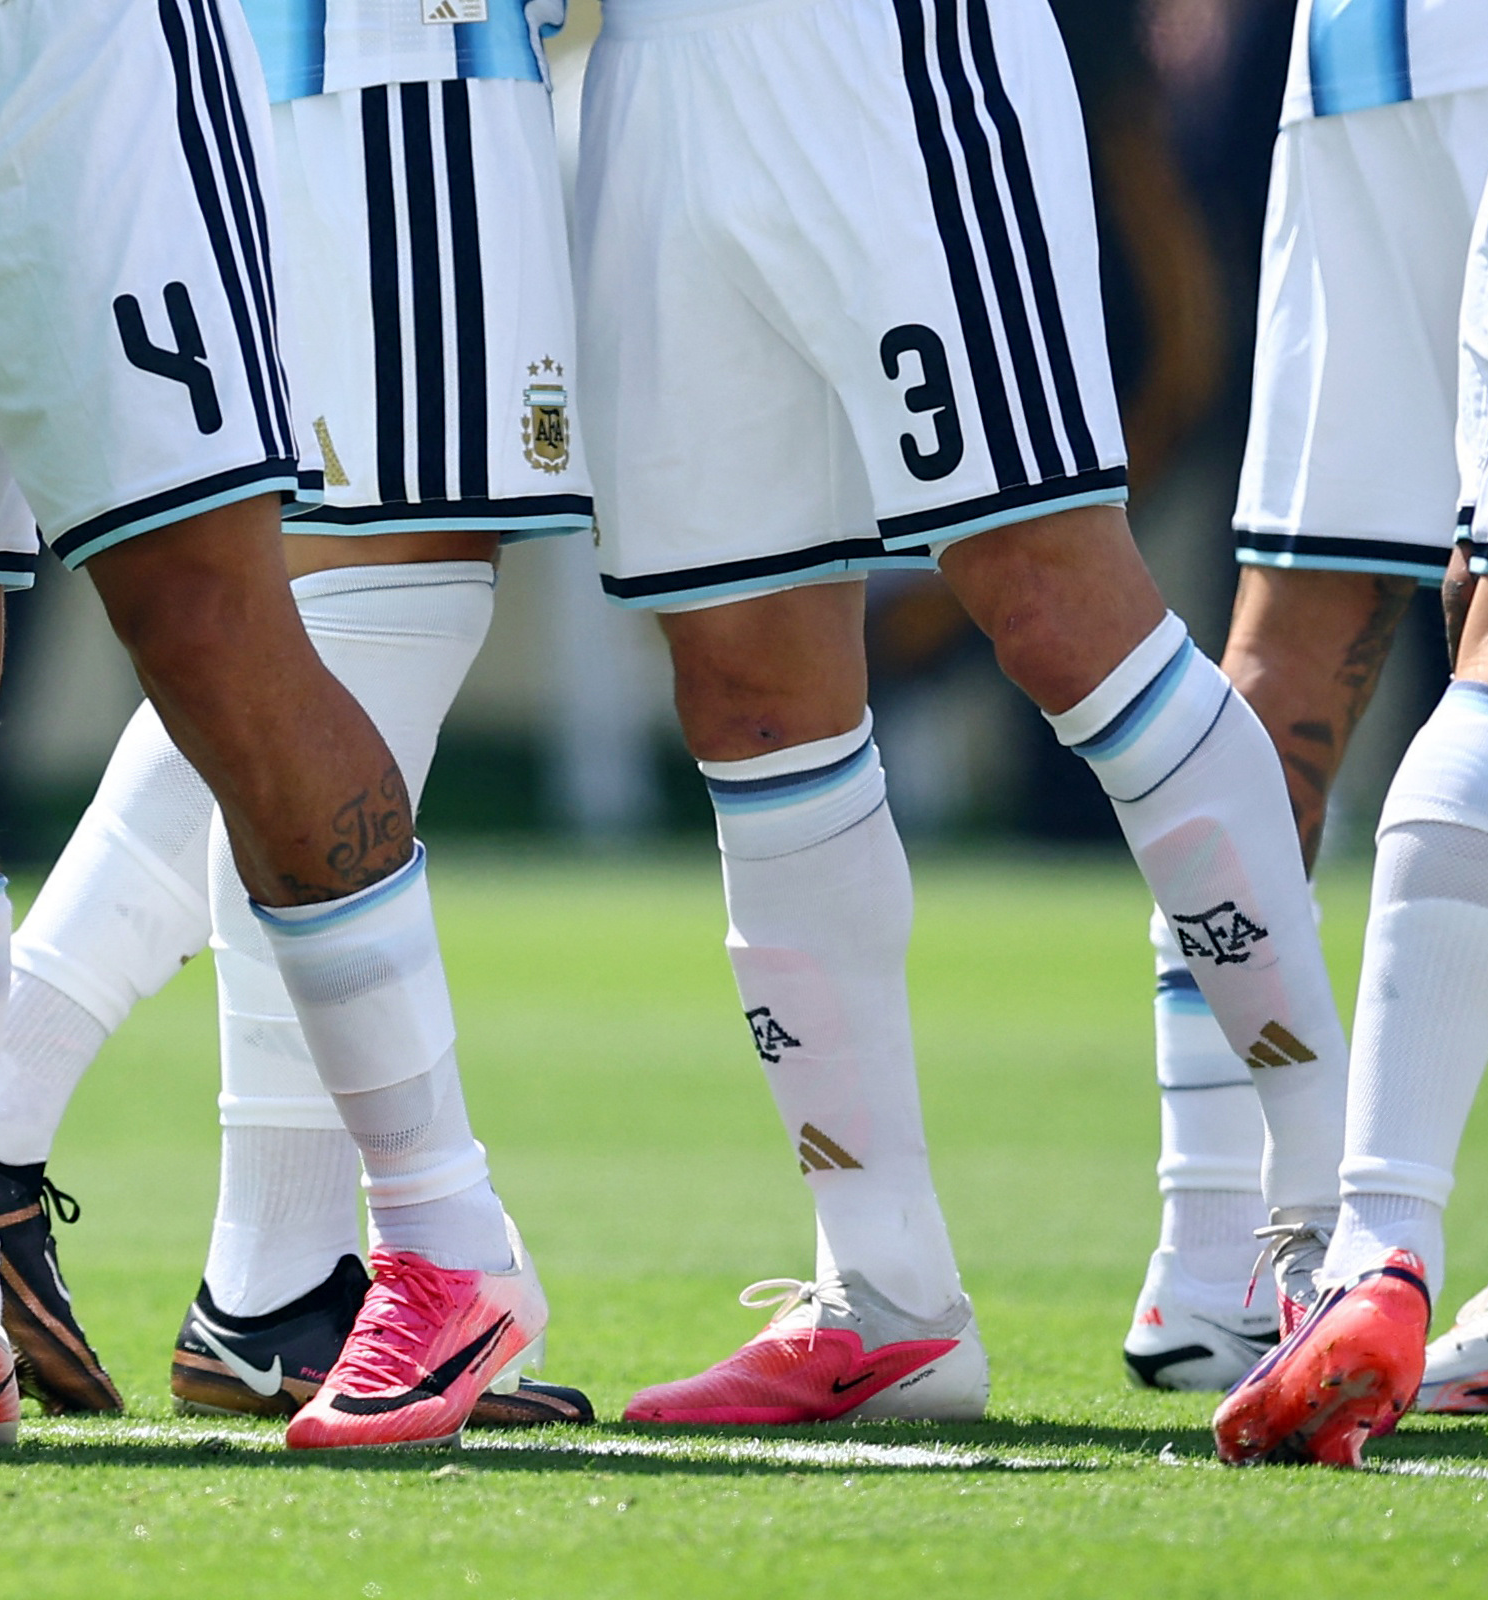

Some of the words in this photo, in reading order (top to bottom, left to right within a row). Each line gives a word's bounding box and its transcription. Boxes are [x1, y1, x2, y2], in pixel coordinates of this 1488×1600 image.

[112, 280, 224, 436] 4
[879, 323, 965, 482] 3
[1172, 901, 1269, 966] AFA
[745, 1006, 802, 1064] FA
